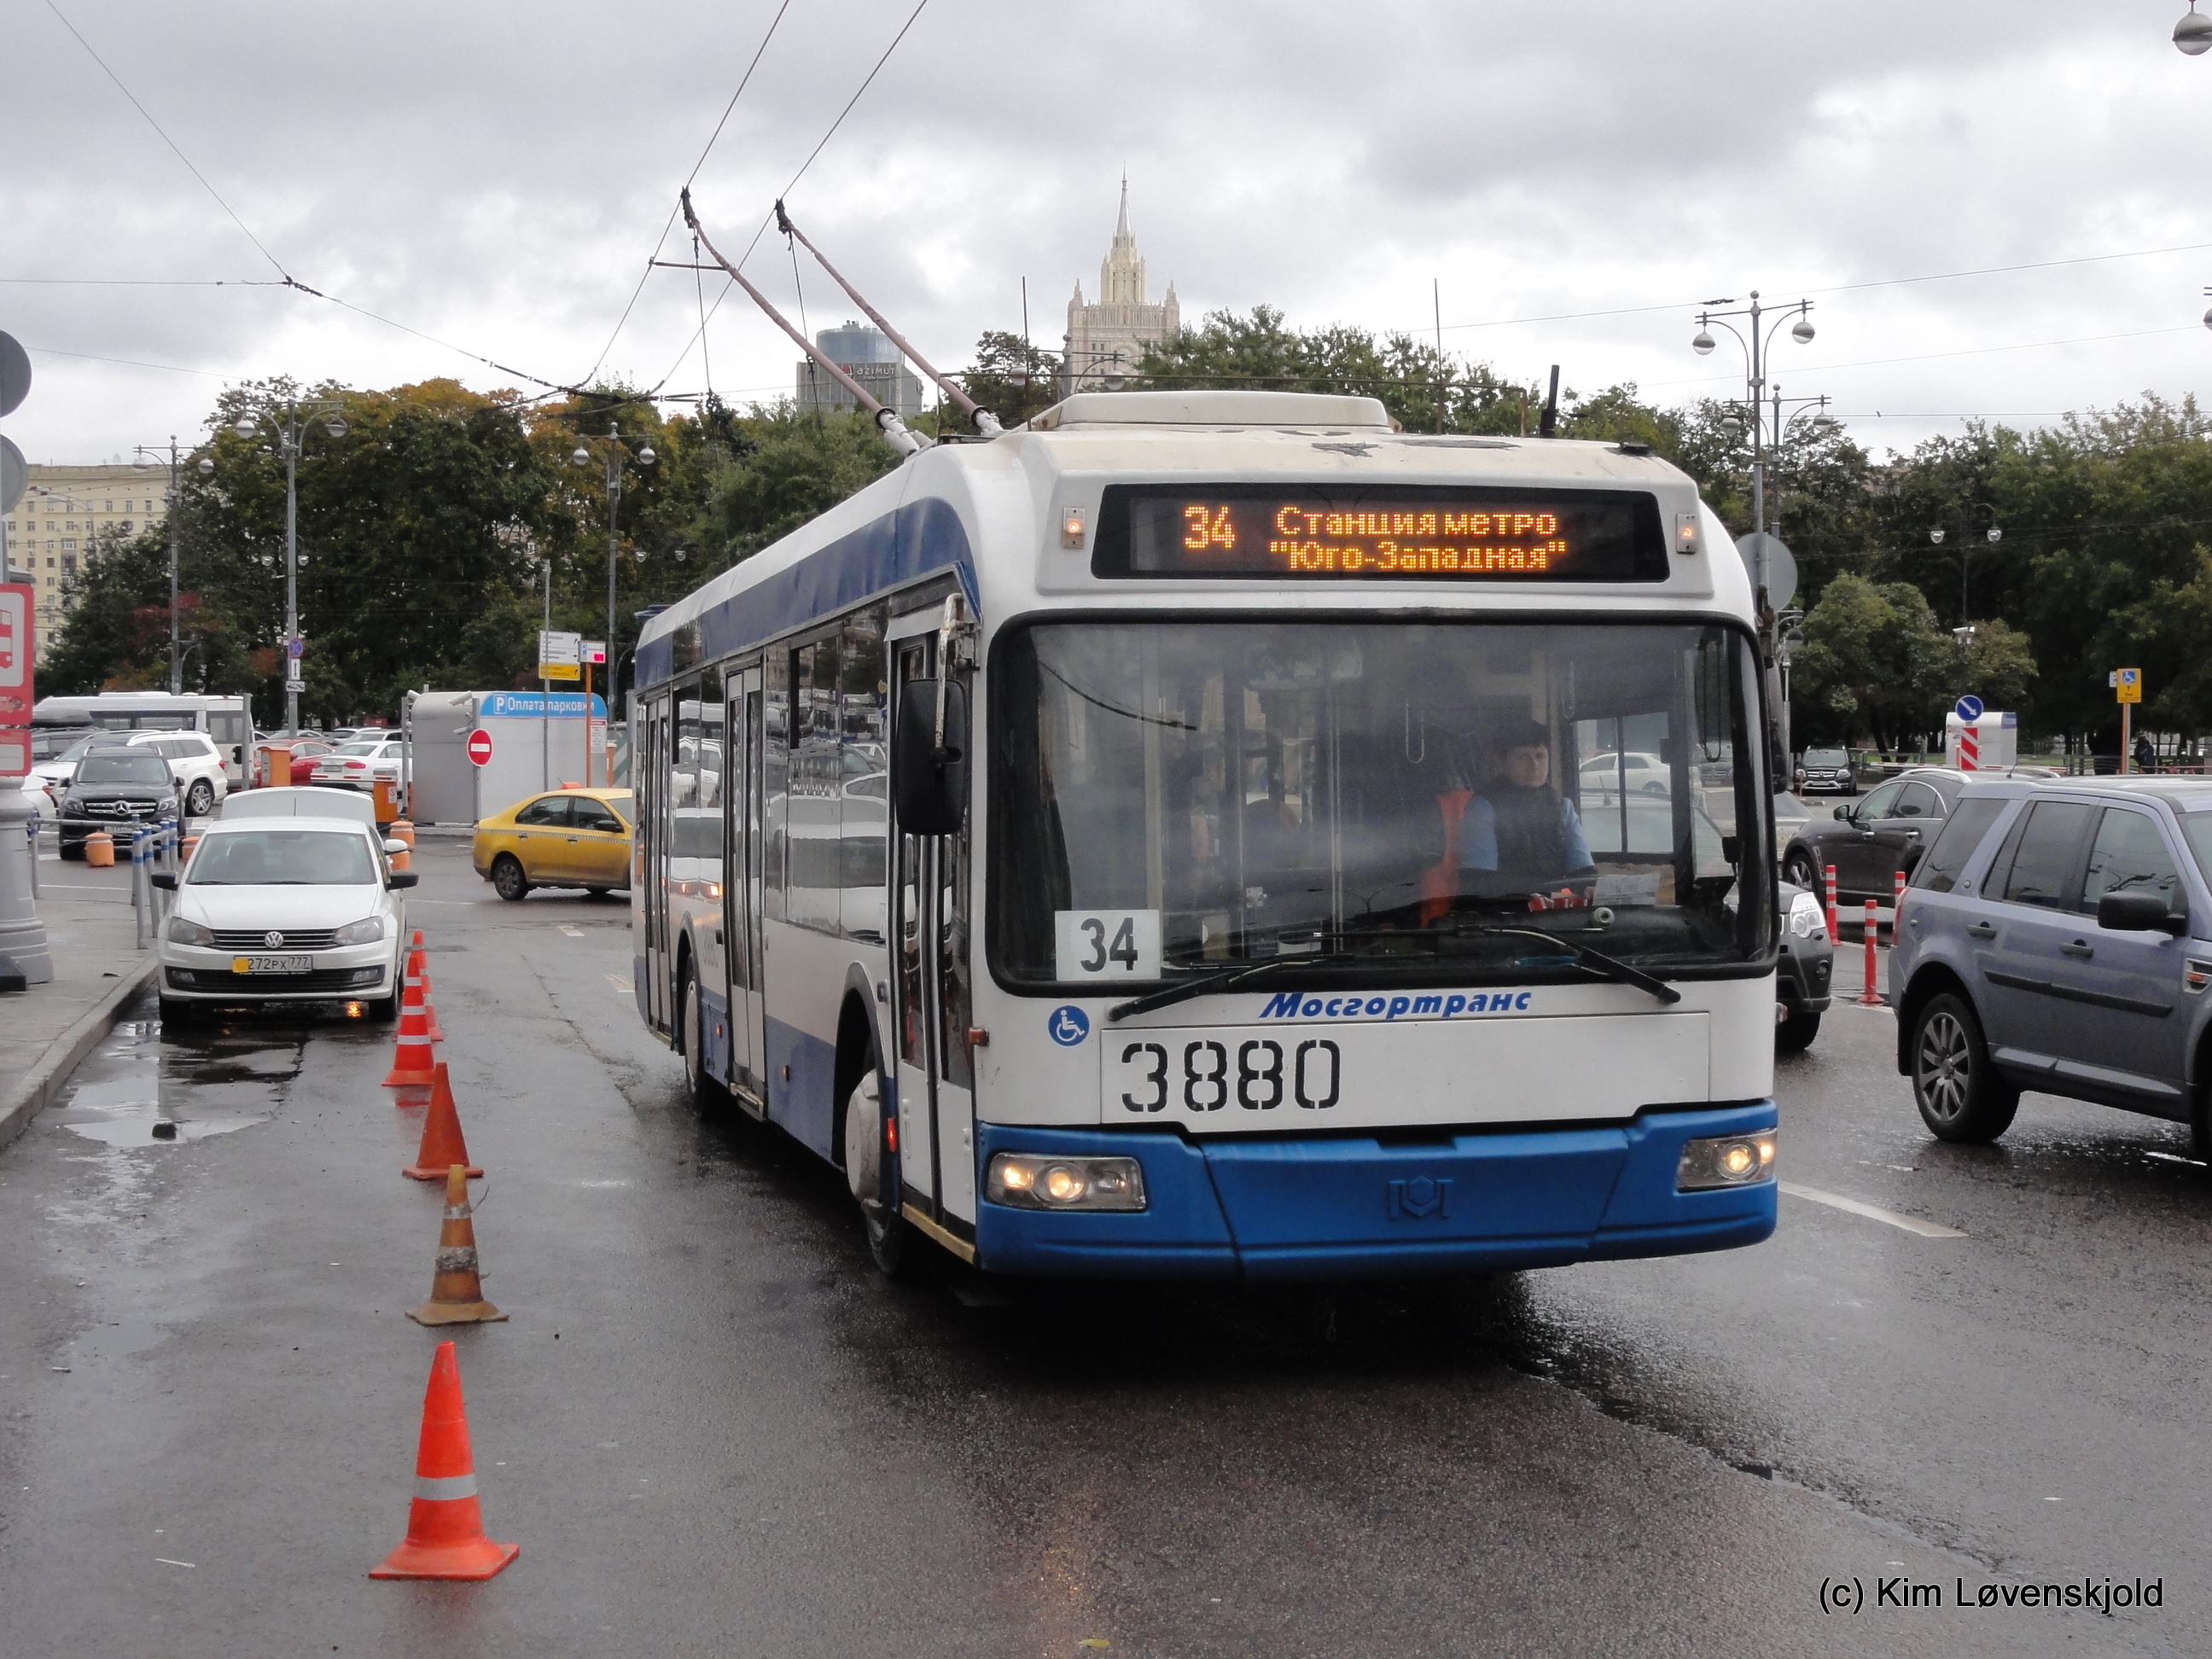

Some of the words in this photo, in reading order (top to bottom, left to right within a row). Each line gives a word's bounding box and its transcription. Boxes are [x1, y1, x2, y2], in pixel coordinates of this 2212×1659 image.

[1185, 506, 1236, 549] 34
[1277, 506, 1436, 536] Станция
[1444, 513, 1558, 536] метро
[1270, 541, 1566, 570] "Юго-Западная"
[508, 697, 545, 711] Оплата
[1080, 917, 1139, 973] 34
[247, 958, 288, 970] 272РХ
[1259, 992, 1533, 1020] Мосгортранс
[1121, 1039, 1341, 1113] 3880
